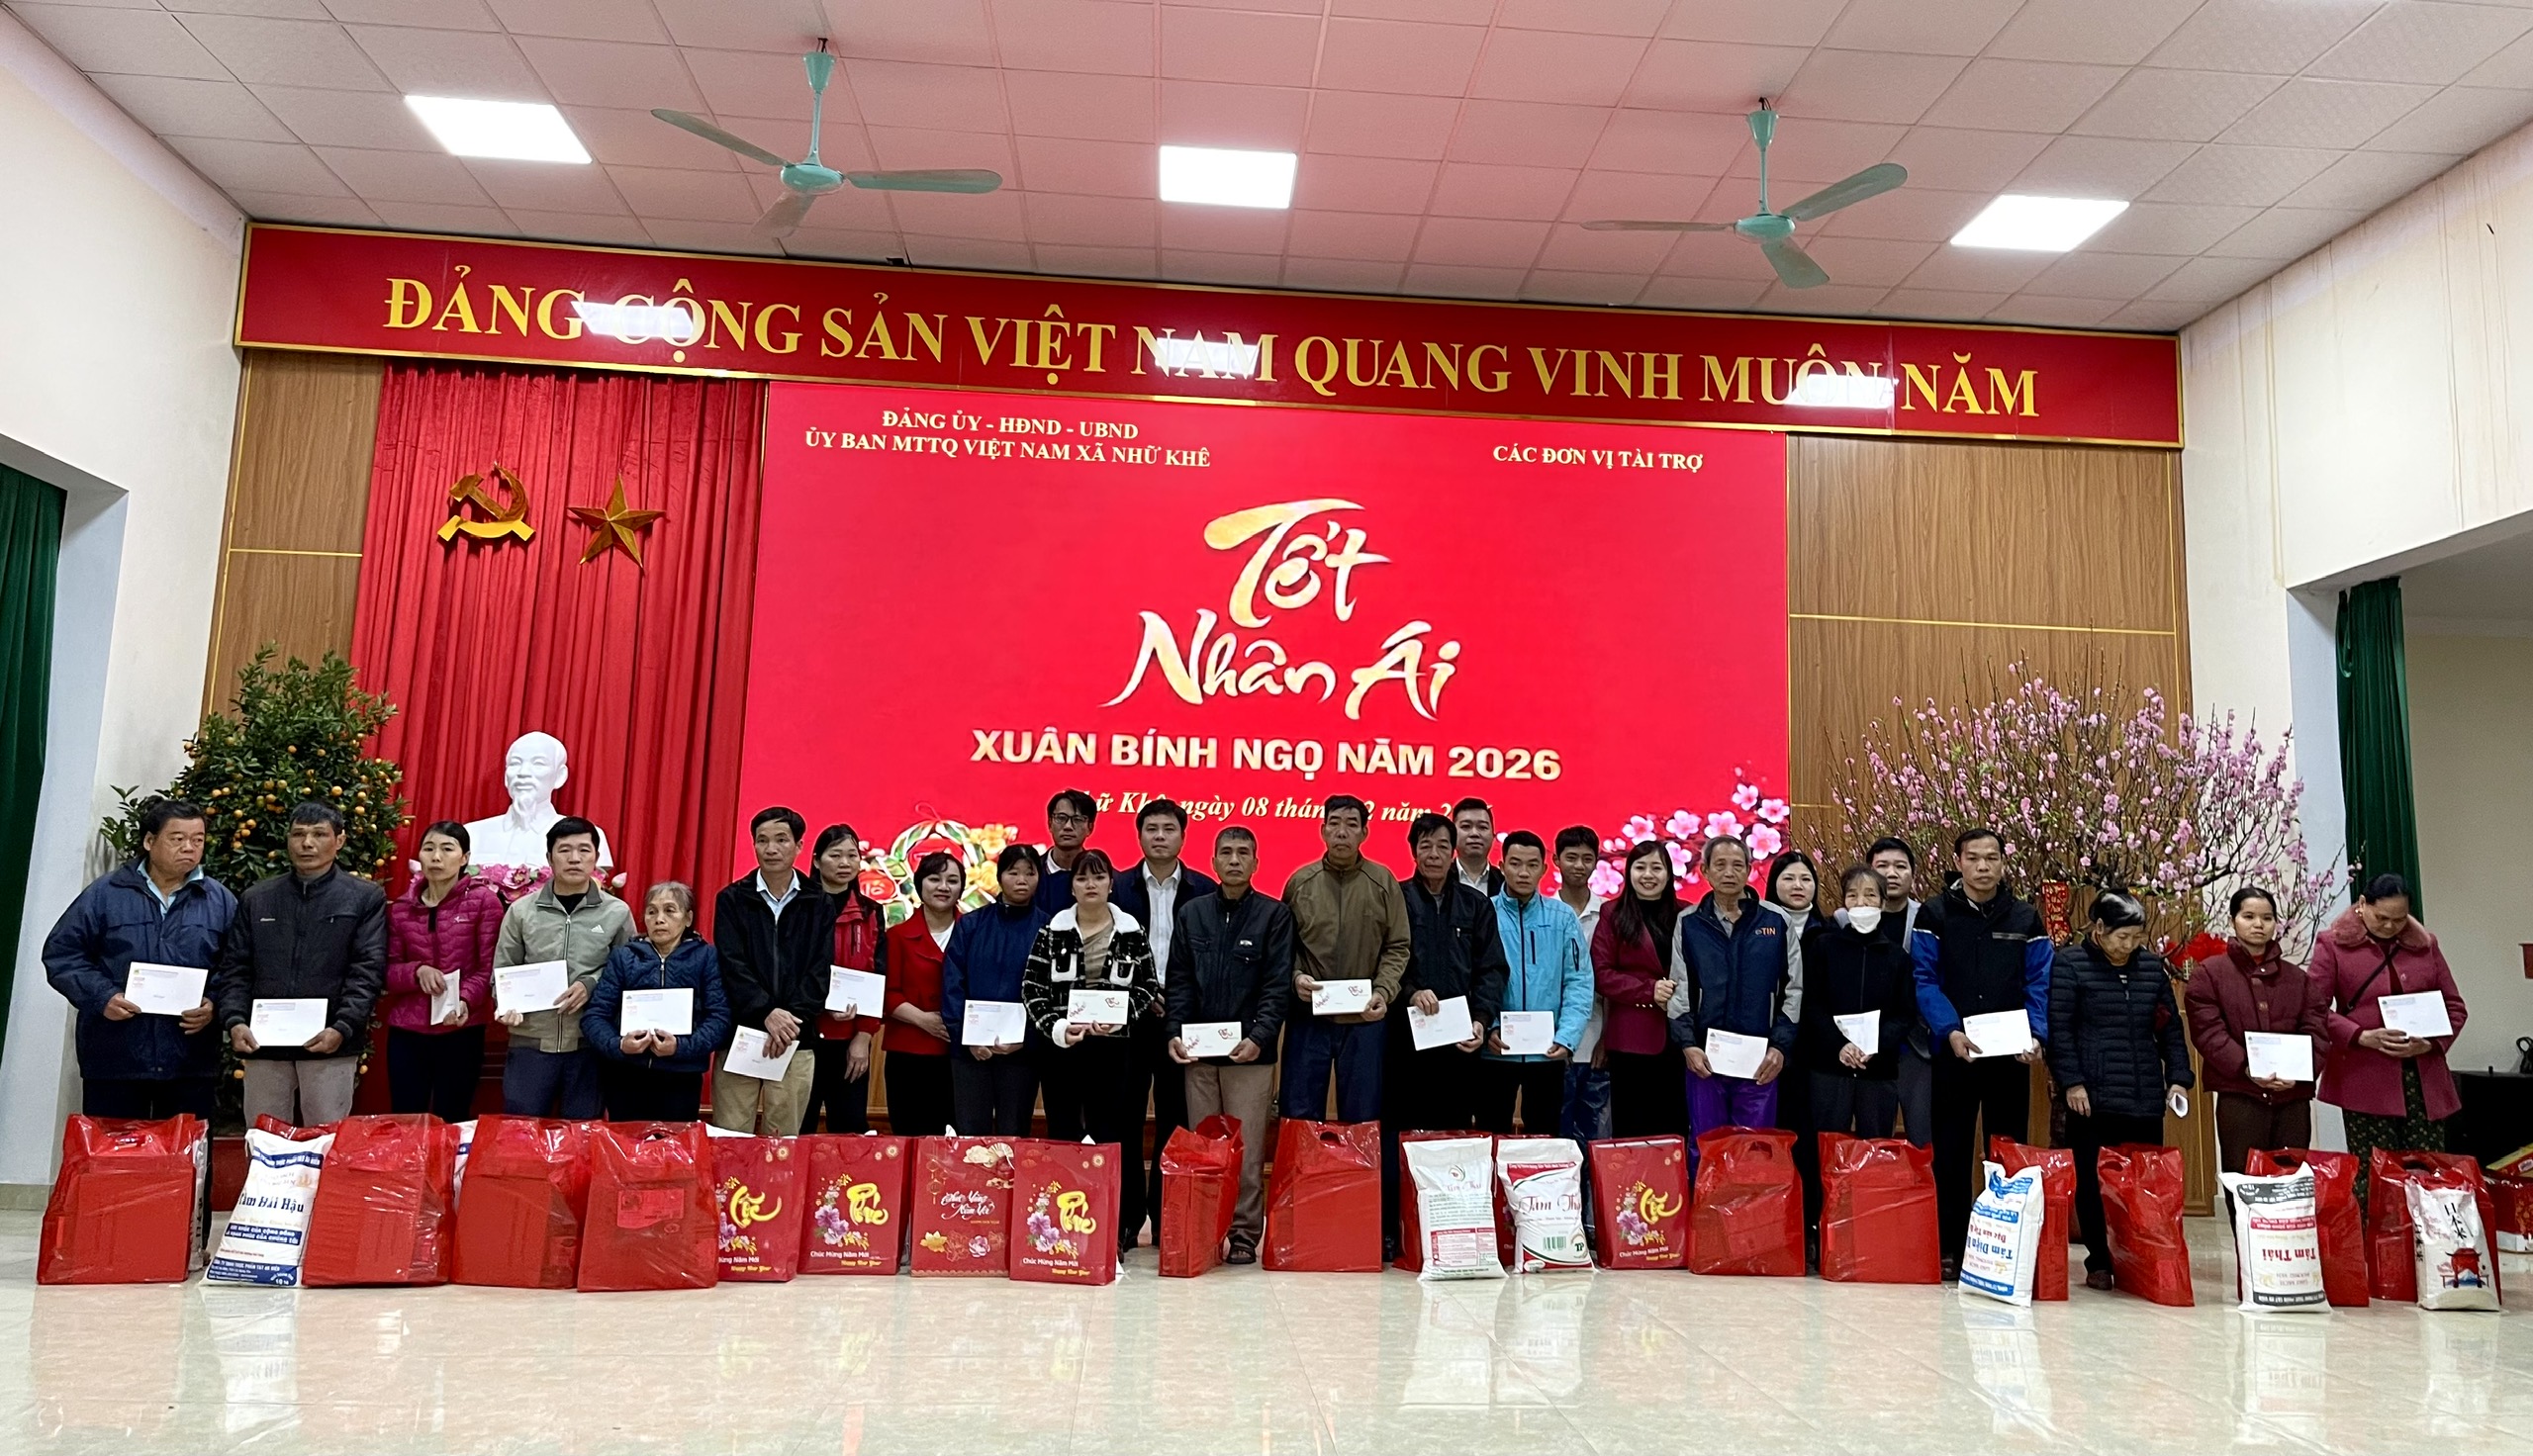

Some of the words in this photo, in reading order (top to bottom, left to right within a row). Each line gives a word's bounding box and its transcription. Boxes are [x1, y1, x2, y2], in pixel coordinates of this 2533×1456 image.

[383, 265, 586, 340] ĐẢNG
[612, 278, 802, 363] CỘNG
[821, 292, 947, 363] SẢN
[965, 304, 1116, 385] VIỆT
[1130, 325, 1279, 383] NAM
[1294, 336, 1510, 397] QUANG
[1527, 347, 1684, 401] VINH
[1900, 352, 2040, 417] NĂM
[805, 426, 836, 448] ỦY
[841, 432, 887, 450] BAN
[891, 436, 959, 458] MTTQ
[964, 438, 1013, 461] VIỆT
[1019, 442, 1071, 461] NAM
[1076, 442, 1106, 462] XÃ
[1111, 444, 1161, 465] NHỮ
[1165, 446, 1211, 468] KHÊ
[883, 407, 946, 428] ĐẢNG
[952, 410, 983, 430] ỦY
[999, 417, 1062, 435] HĐND
[1079, 421, 1139, 439] UBND
[1492, 443, 1538, 463] CÁC
[1542, 447, 1586, 465] ĐƠN
[1591, 450, 1614, 470] VỊ
[1618, 448, 1654, 468] TÀI
[1658, 453, 1704, 474] TRỢ
[1203, 498, 1392, 628] Tết
[1098, 608, 1336, 708] Nhân
[1348, 620, 1462, 721] Ái
[970, 726, 1096, 765] XUÂN
[1110, 729, 1218, 769] BÍNH
[1233, 738, 1324, 781] NGỌ
[1338, 737, 1434, 776] NĂM
[1448, 746, 1561, 780] 2026
[1180, 795, 1235, 822] ngày
[1242, 797, 1269, 817] 08
[1275, 797, 1326, 819] thán
